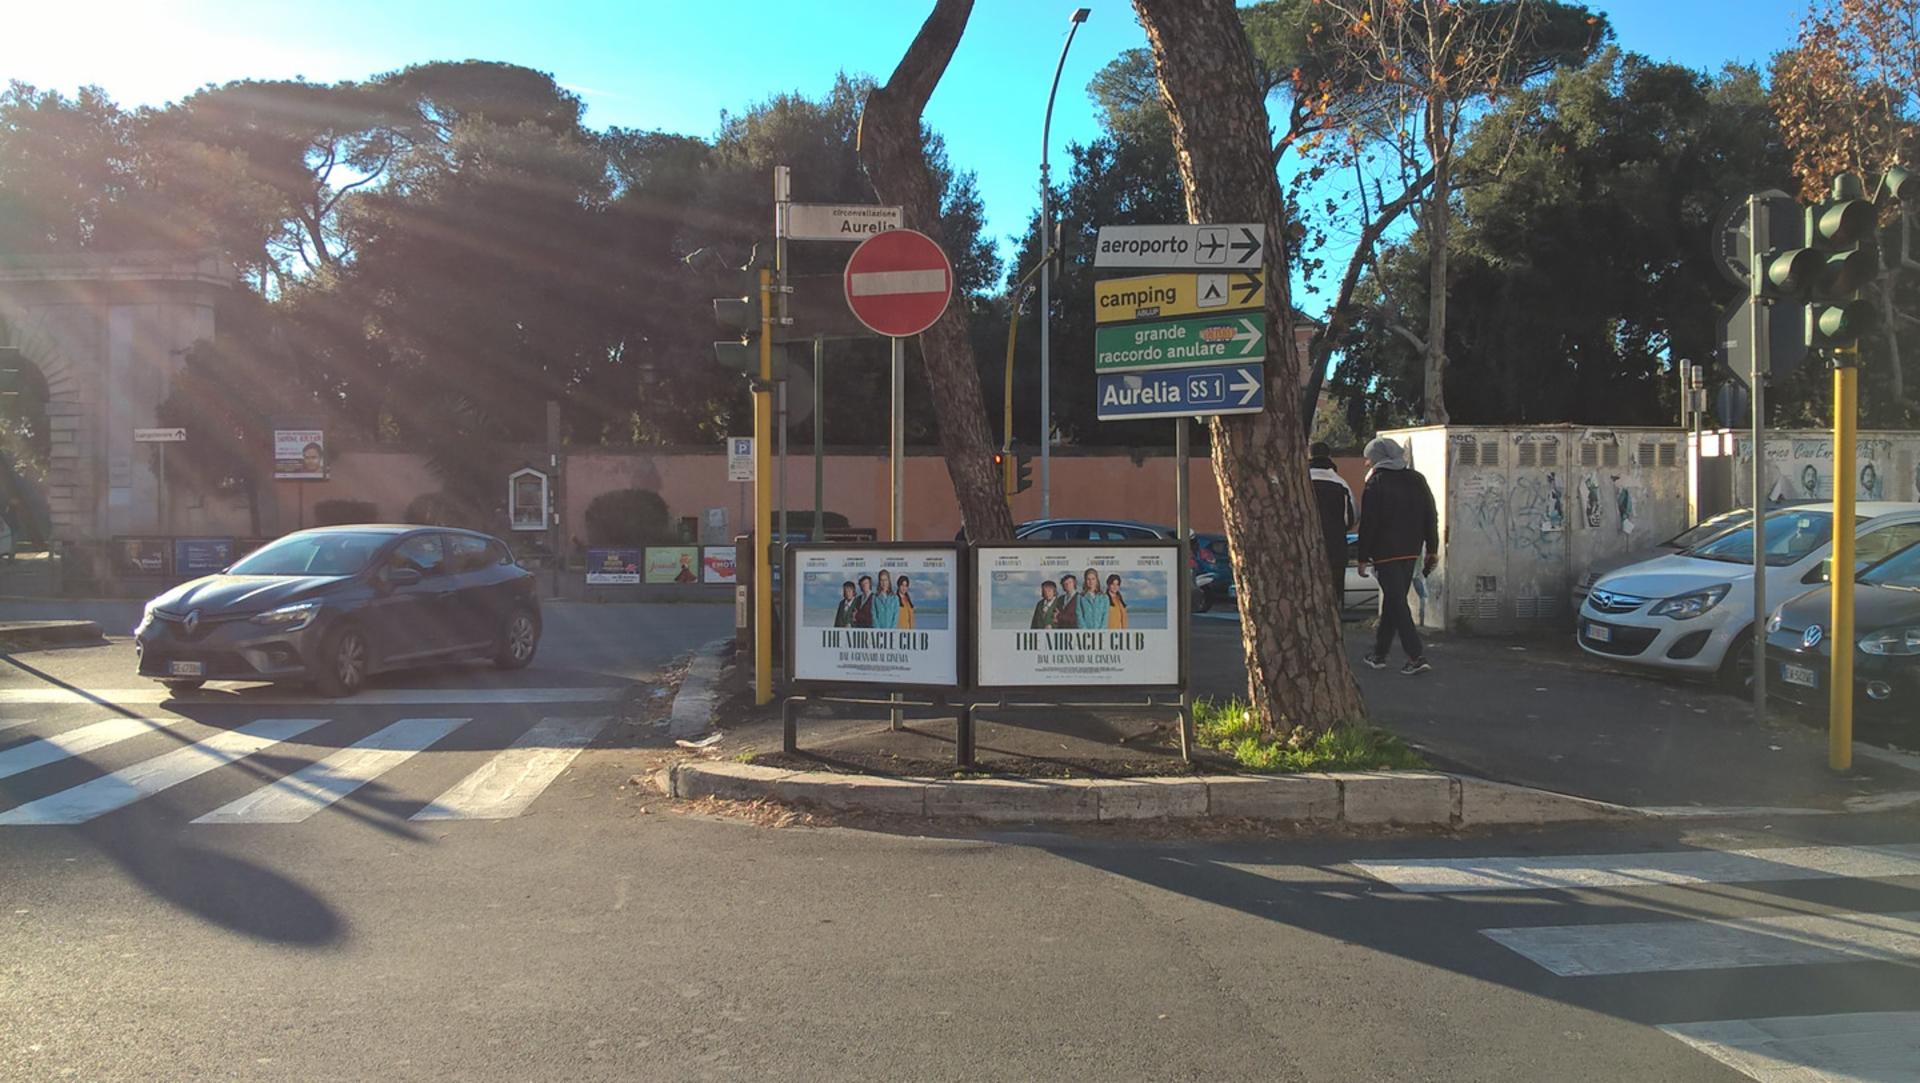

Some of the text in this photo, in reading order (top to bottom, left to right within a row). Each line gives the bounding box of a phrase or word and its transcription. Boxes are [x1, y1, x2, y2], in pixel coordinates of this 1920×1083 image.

[832, 208, 897, 218] circonvallazione
[840, 220, 896, 233] Aurelia
[1101, 236, 1189, 256] aeroporto
[1100, 286, 1177, 308] camping
[1135, 325, 1187, 345] grande
[1099, 342, 1226, 363] raccordo anulare
[1102, 379, 1221, 406] Aurelia SS 1
[822, 630, 929, 651] THE MIRACLE CLUB
[1016, 632, 1145, 651] THE MIRACLE CLUB
